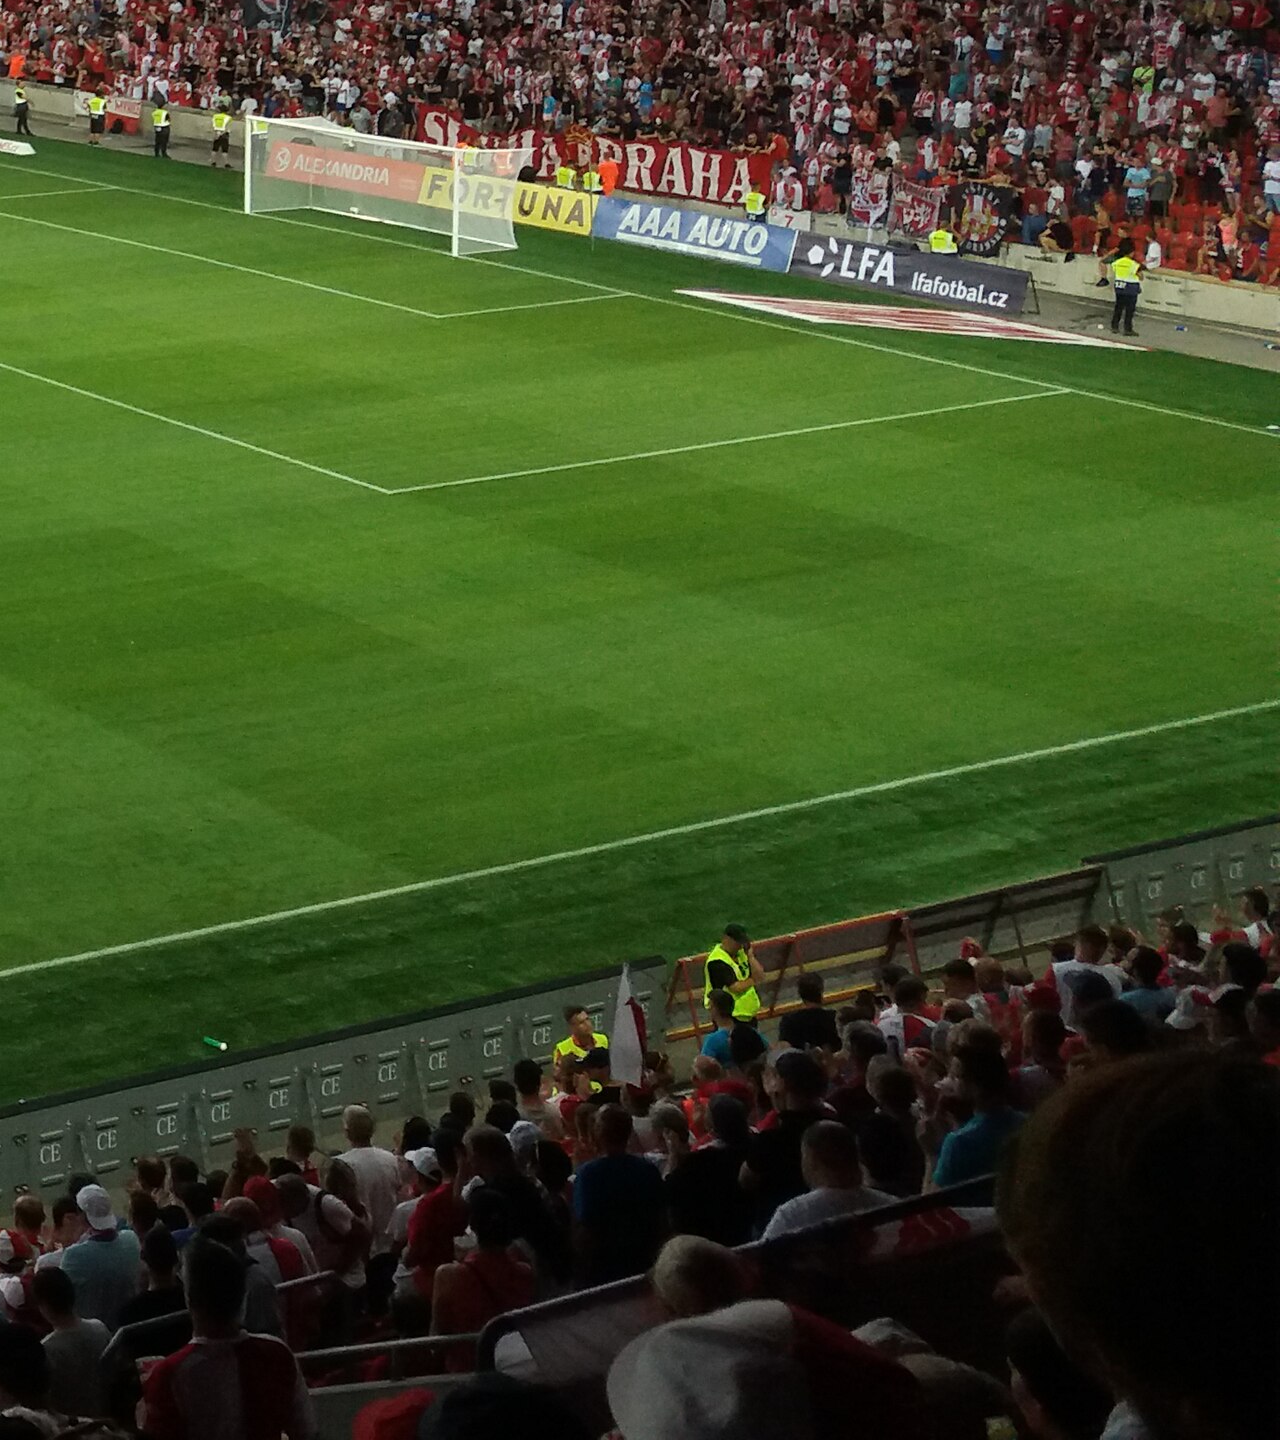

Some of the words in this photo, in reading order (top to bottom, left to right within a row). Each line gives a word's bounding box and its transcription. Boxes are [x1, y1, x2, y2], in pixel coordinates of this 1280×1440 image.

[423, 111, 563, 178] SLIA
[598, 136, 753, 204] PRAHA
[293, 153, 389, 187] ALEXANDRIA
[427, 174, 585, 227] FORTUNA
[618, 204, 681, 240] AAA
[686, 214, 769, 255] AUTO
[839, 244, 895, 287] LFA
[911, 271, 1009, 308] lfafotbal.cz
[483, 1037, 503, 1059] CE
[428, 1050, 449, 1072] CE
[378, 1062, 398, 1084] CE
[321, 1075, 342, 1097] CE
[268, 1089, 290, 1110] CE
[210, 1102, 232, 1124] CE
[156, 1114, 178, 1137] CE
[96, 1129, 118, 1151] CE
[40, 1143, 62, 1165] CE
